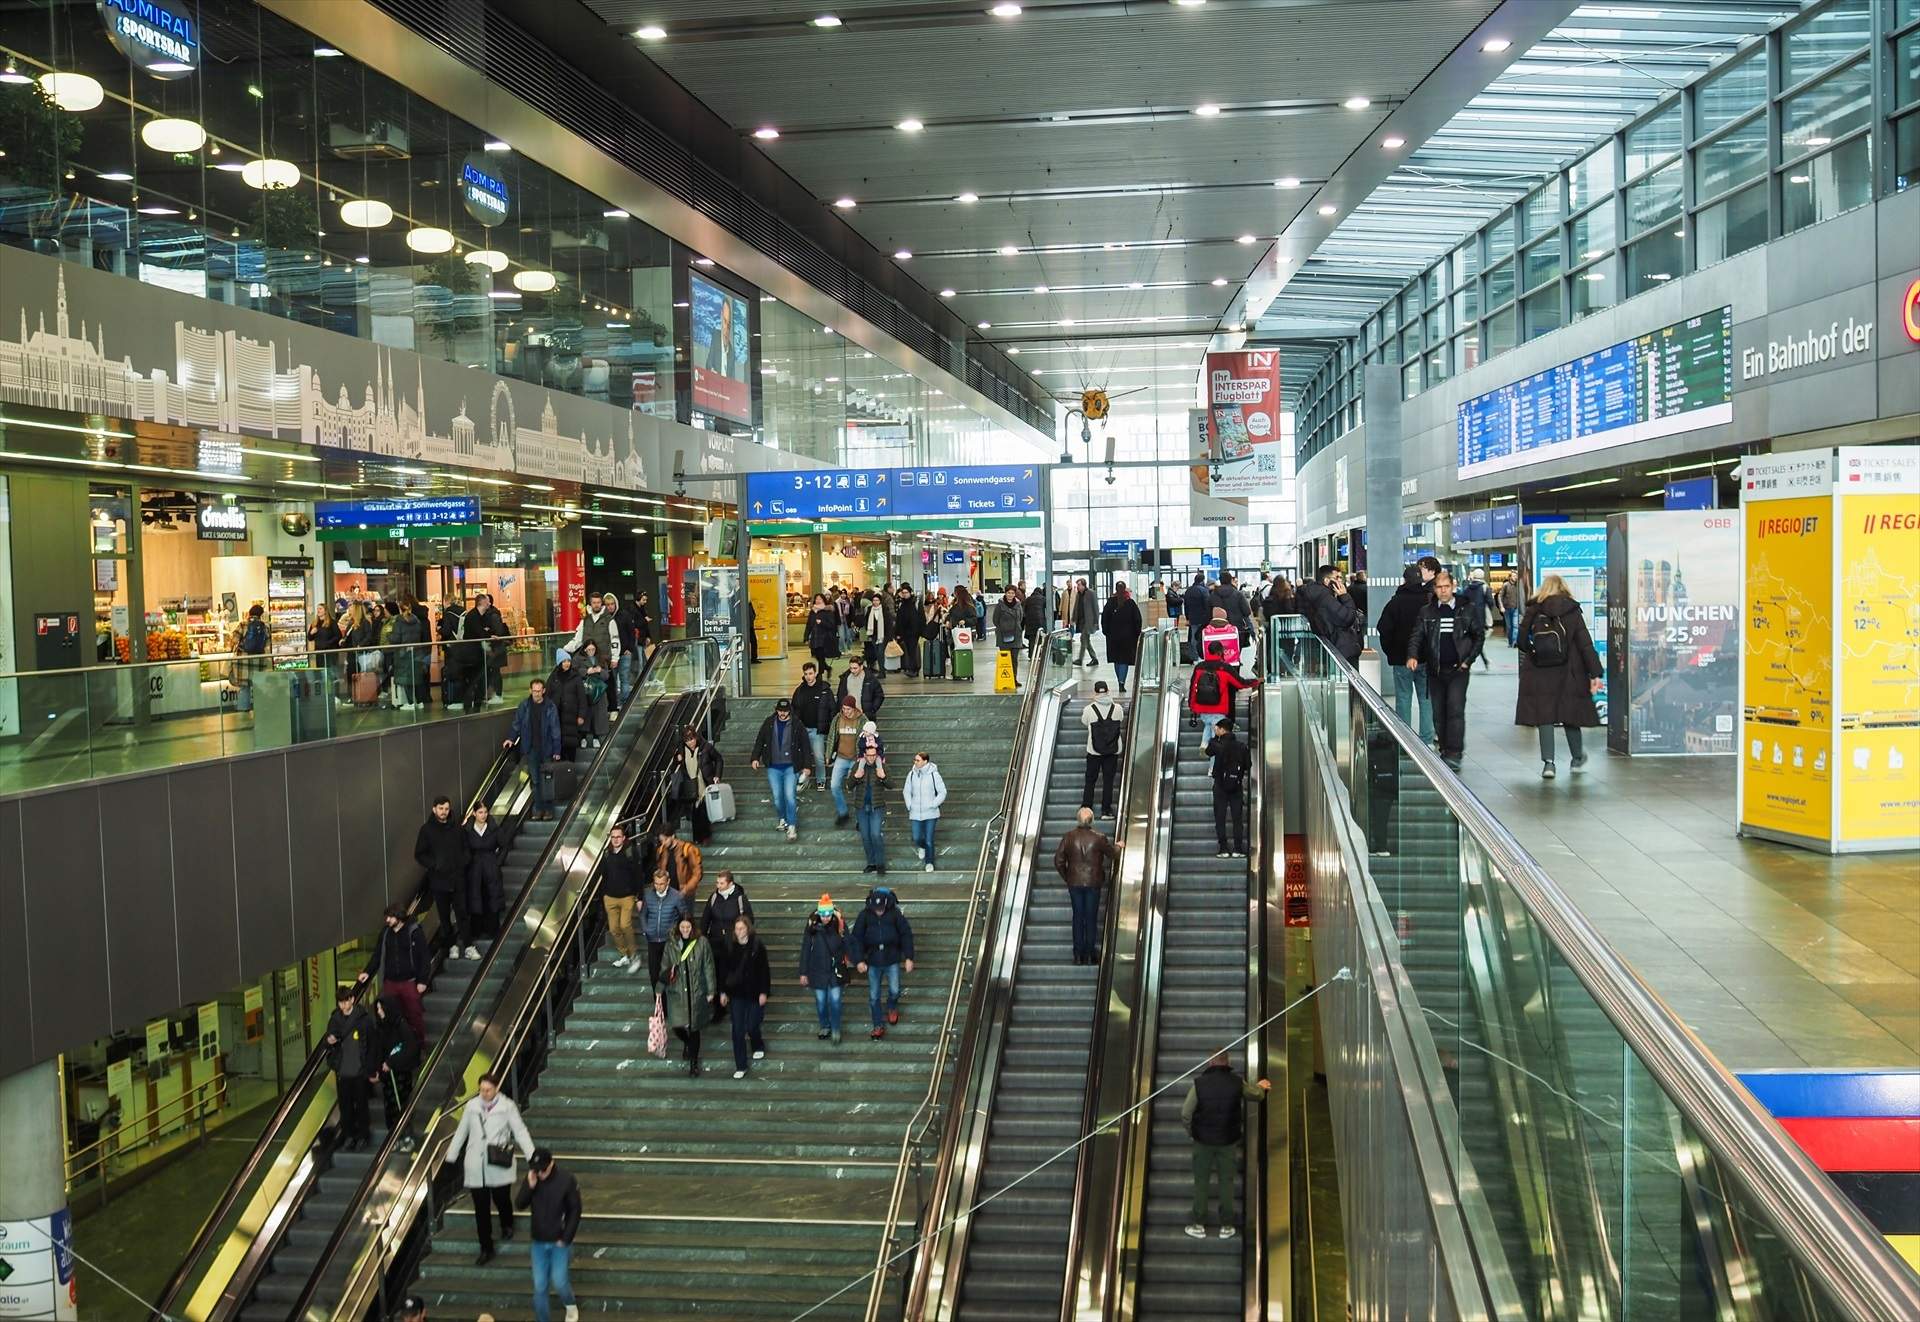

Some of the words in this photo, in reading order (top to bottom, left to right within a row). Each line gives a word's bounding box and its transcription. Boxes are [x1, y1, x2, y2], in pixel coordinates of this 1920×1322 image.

[122, 16, 190, 63] SPORTSBAR
[464, 165, 508, 201] ADMIRAL
[1743, 347, 1764, 380] Ein
[1768, 322, 1839, 373] Bahnhof
[1841, 317, 1873, 355] der
[1215, 373, 1228, 381] Ihr
[1215, 381, 1267, 391] INTERSPAR
[1215, 390, 1260, 402] Flugblatt
[1864, 459, 1889, 468] TICKET
[1892, 459, 1916, 467] SALES
[1755, 466, 1772, 476] TICKET
[1773, 465, 1786, 475] SALES
[953, 475, 1016, 486] Sonnwendgasse
[412, 500, 466, 511] Sonnwendgasse
[818, 503, 853, 513] InfoPoint
[968, 499, 996, 509] Tickets
[1767, 517, 1818, 536] REGIOJET
[1609, 607, 1627, 629] PRAG
[1637, 603, 1734, 622] MÜNCHEN
